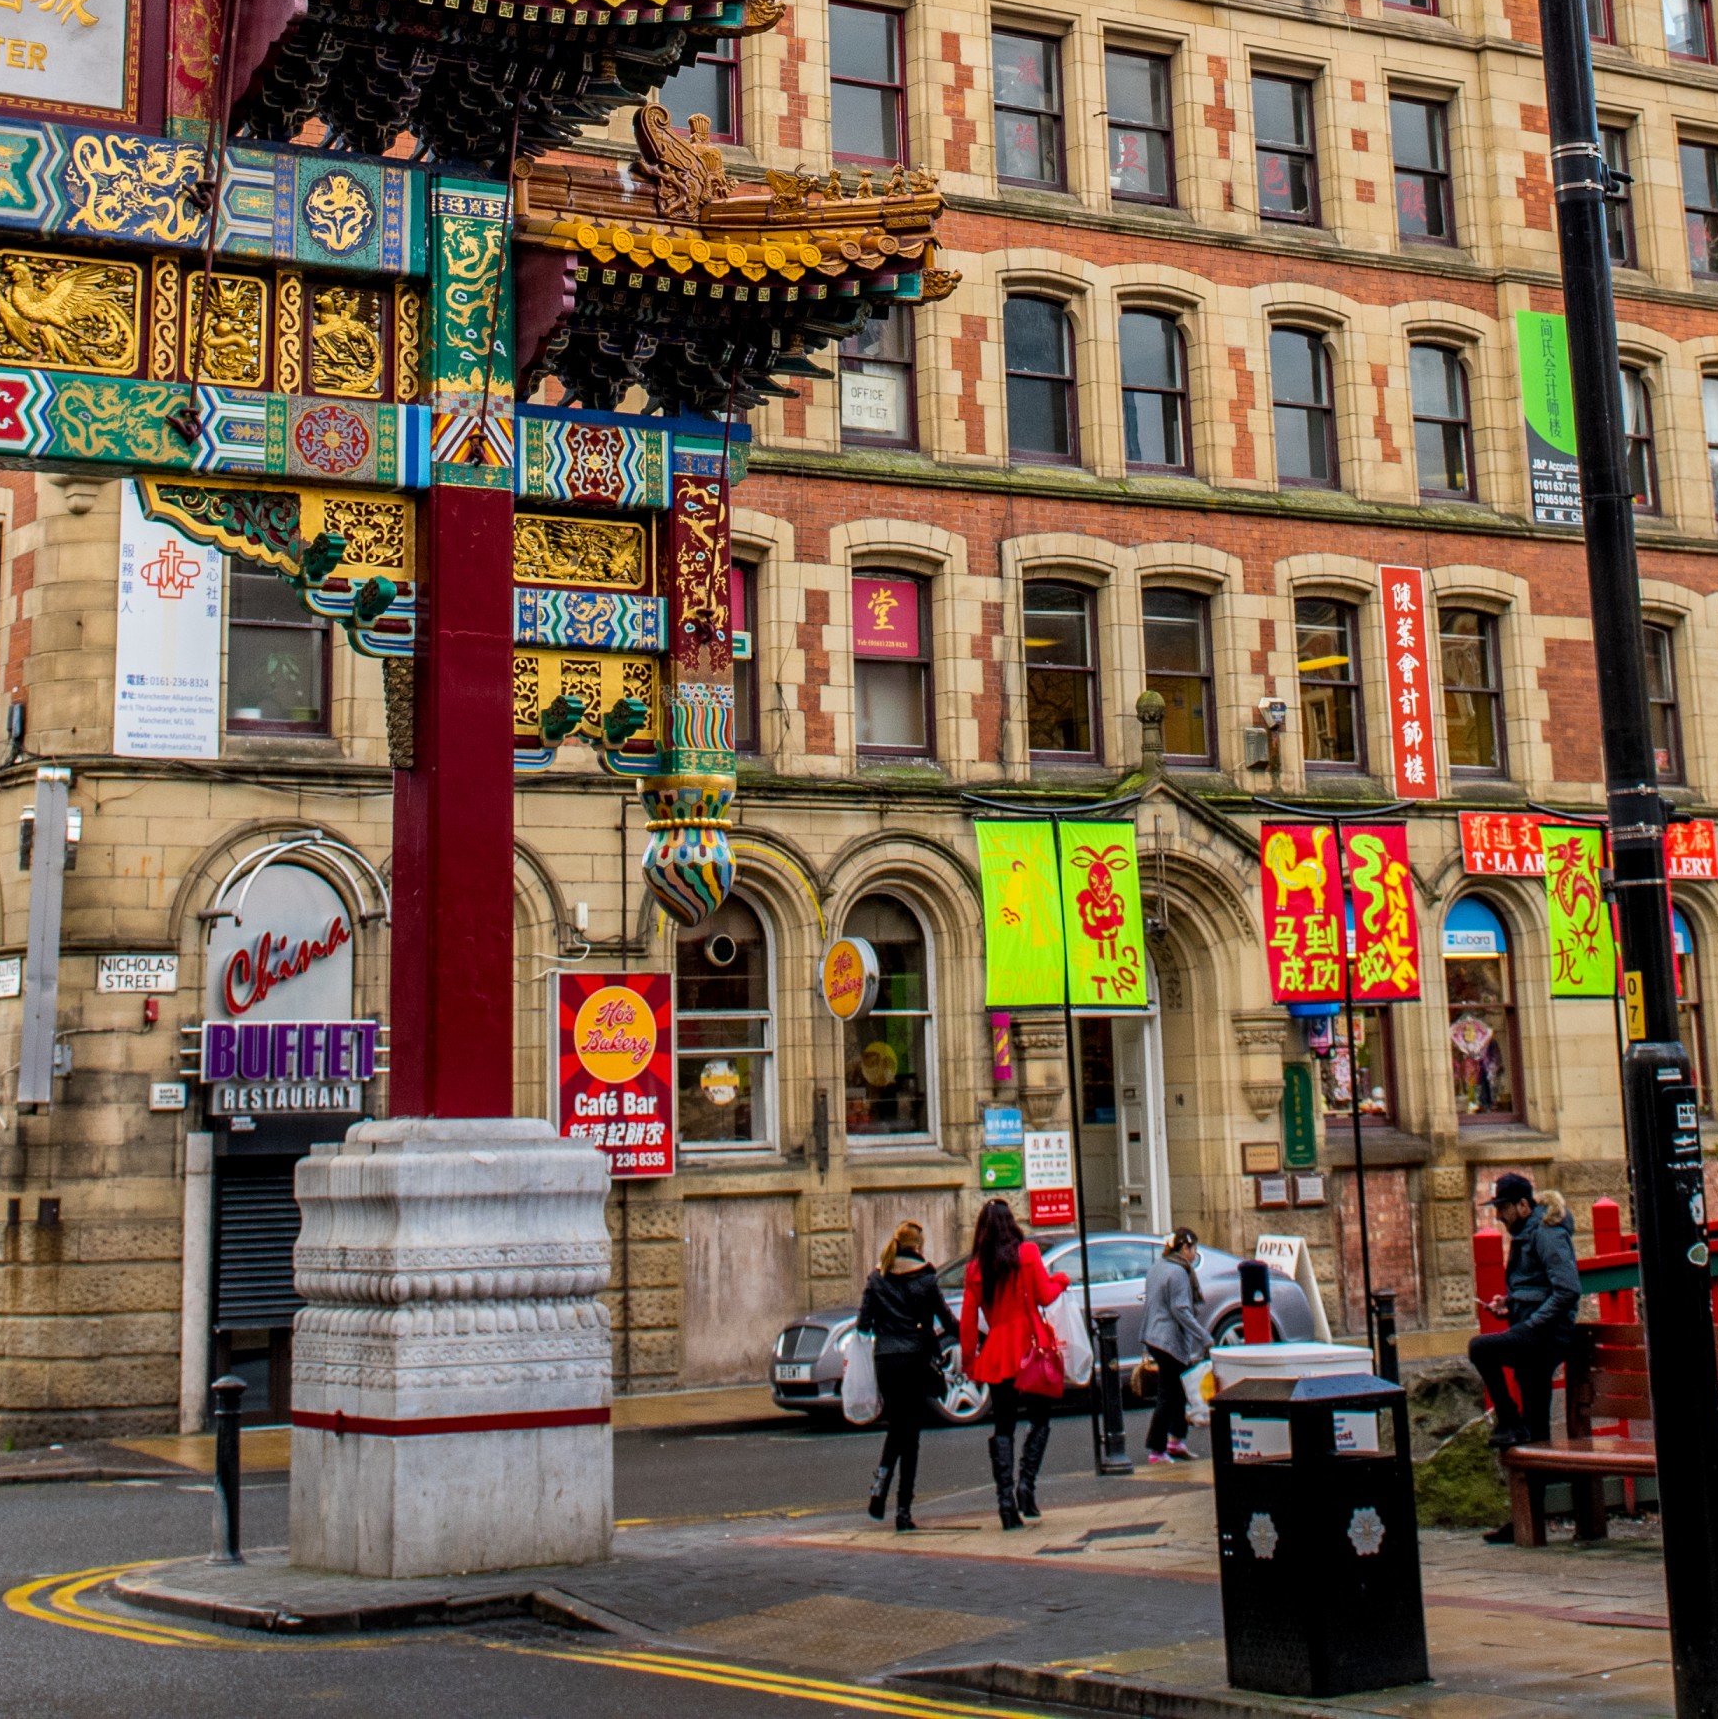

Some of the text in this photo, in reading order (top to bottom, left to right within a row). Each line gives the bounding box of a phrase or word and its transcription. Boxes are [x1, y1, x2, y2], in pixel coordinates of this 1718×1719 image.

[851, 387, 884, 401] OFFICE
[851, 405, 888, 419] TO LET
[1533, 459, 1547, 469] J&P
[1534, 480, 1567, 492] 0161 637
[1536, 508, 1546, 519] UK
[868, 588, 898, 630] 堂
[150, 676, 209, 687] 0161-236-8324
[1269, 914, 1339, 957] 马到
[1382, 861, 1417, 992] SNAKE
[100, 957, 175, 973] NICHOLAS
[224, 916, 351, 1016] China
[1279, 955, 1339, 992] 成功
[1358, 941, 1392, 992] 蛇
[106, 974, 161, 989] STREET
[595, 999, 637, 1029] Ho's
[207, 1023, 380, 1080] BUFFET
[581, 1028, 651, 1064] Bakery
[223, 1086, 356, 1110] RESTAURANT
[574, 1090, 658, 1117] Café Bar
[616, 1152, 665, 1168] 236 8335
[1259, 1241, 1294, 1256] OPEN
